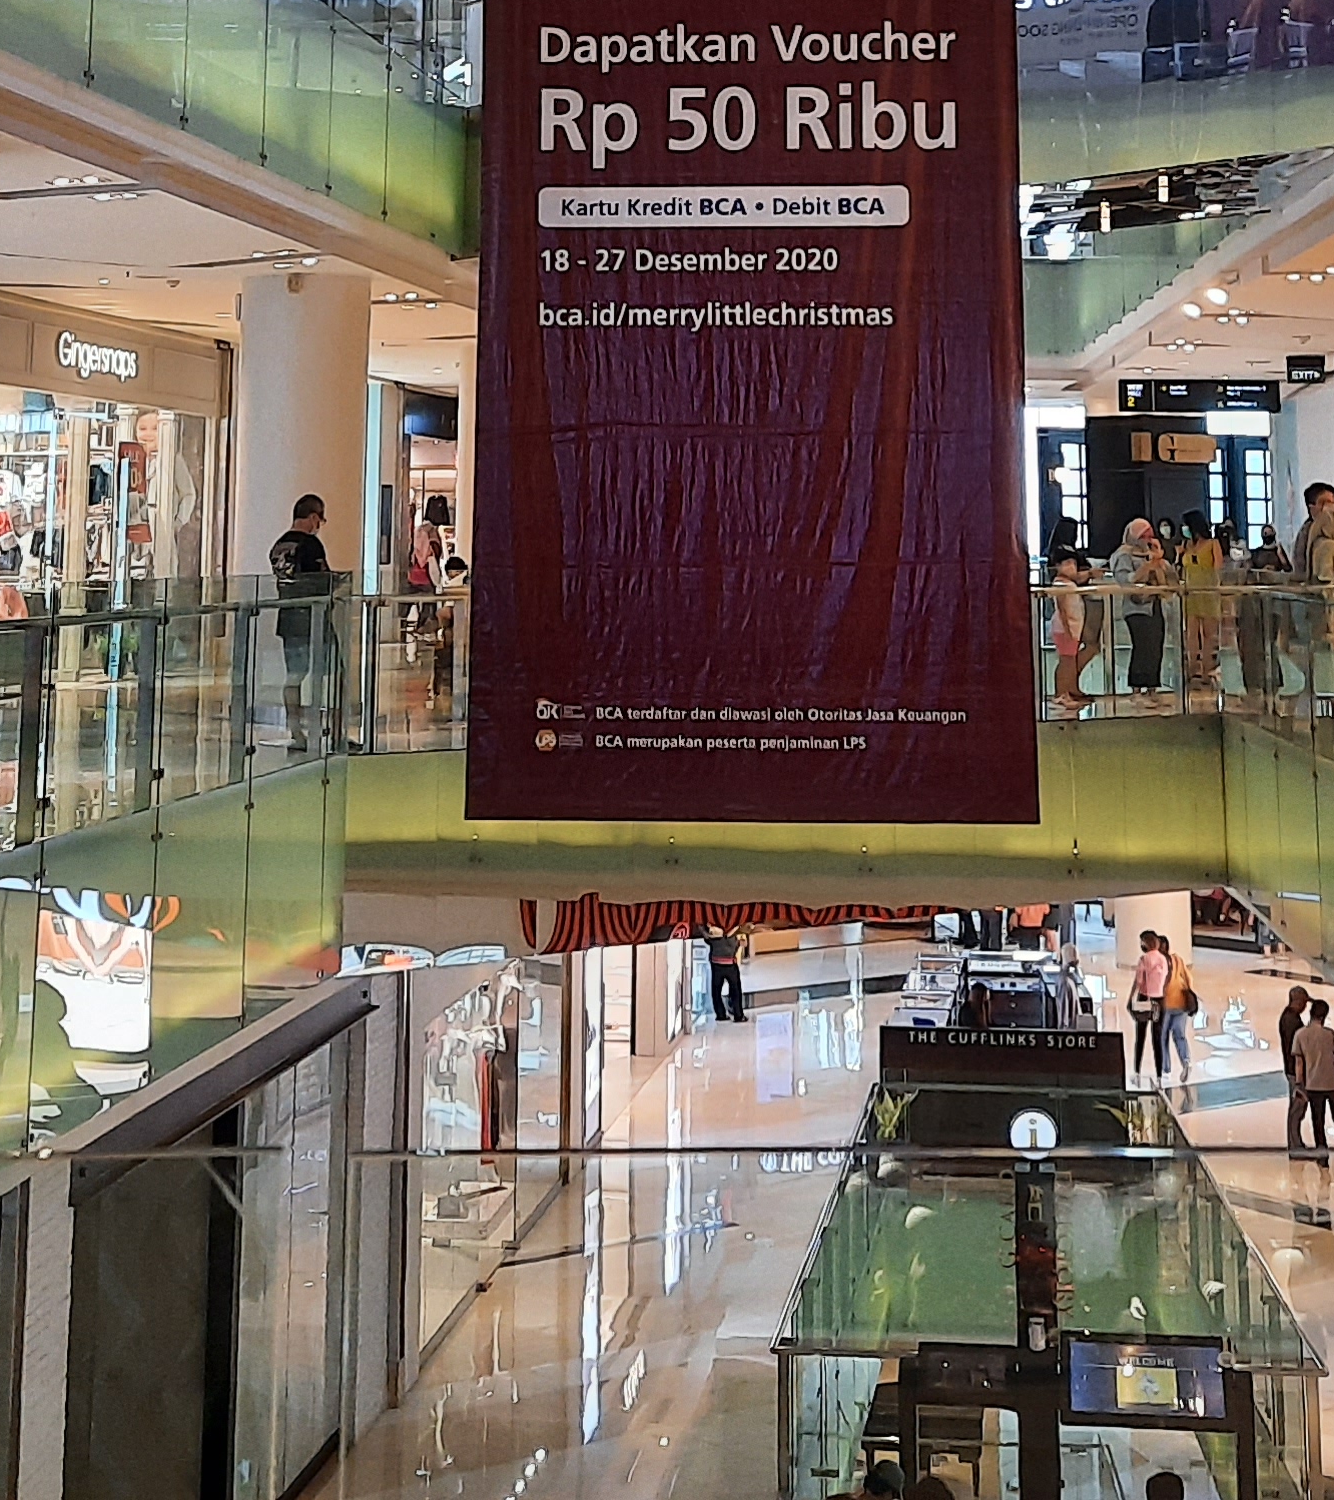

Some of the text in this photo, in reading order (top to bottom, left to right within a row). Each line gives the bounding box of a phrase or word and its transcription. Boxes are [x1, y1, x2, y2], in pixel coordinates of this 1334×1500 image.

[538, 21, 957, 73] Dapatkan Voucher
[538, 81, 958, 170] Rp 50 Ribu
[560, 196, 885, 217] Kartu Kredit BCA Debit BCA
[540, 249, 571, 272] 18
[594, 249, 625, 272] 27
[634, 247, 768, 273] Desember
[774, 248, 839, 273] 2020
[538, 301, 894, 333] bca.id/merrylittlechristmas
[58, 330, 139, 382] Gingersnaps
[595, 706, 623, 720] BCA
[690, 706, 716, 720] dan
[807, 707, 863, 721] Otoritas
[865, 708, 894, 722] Jasa
[595, 734, 623, 749] BCA
[843, 735, 867, 750] LPS
[907, 1030, 1097, 1049] THE CUFFLINKS STORE
